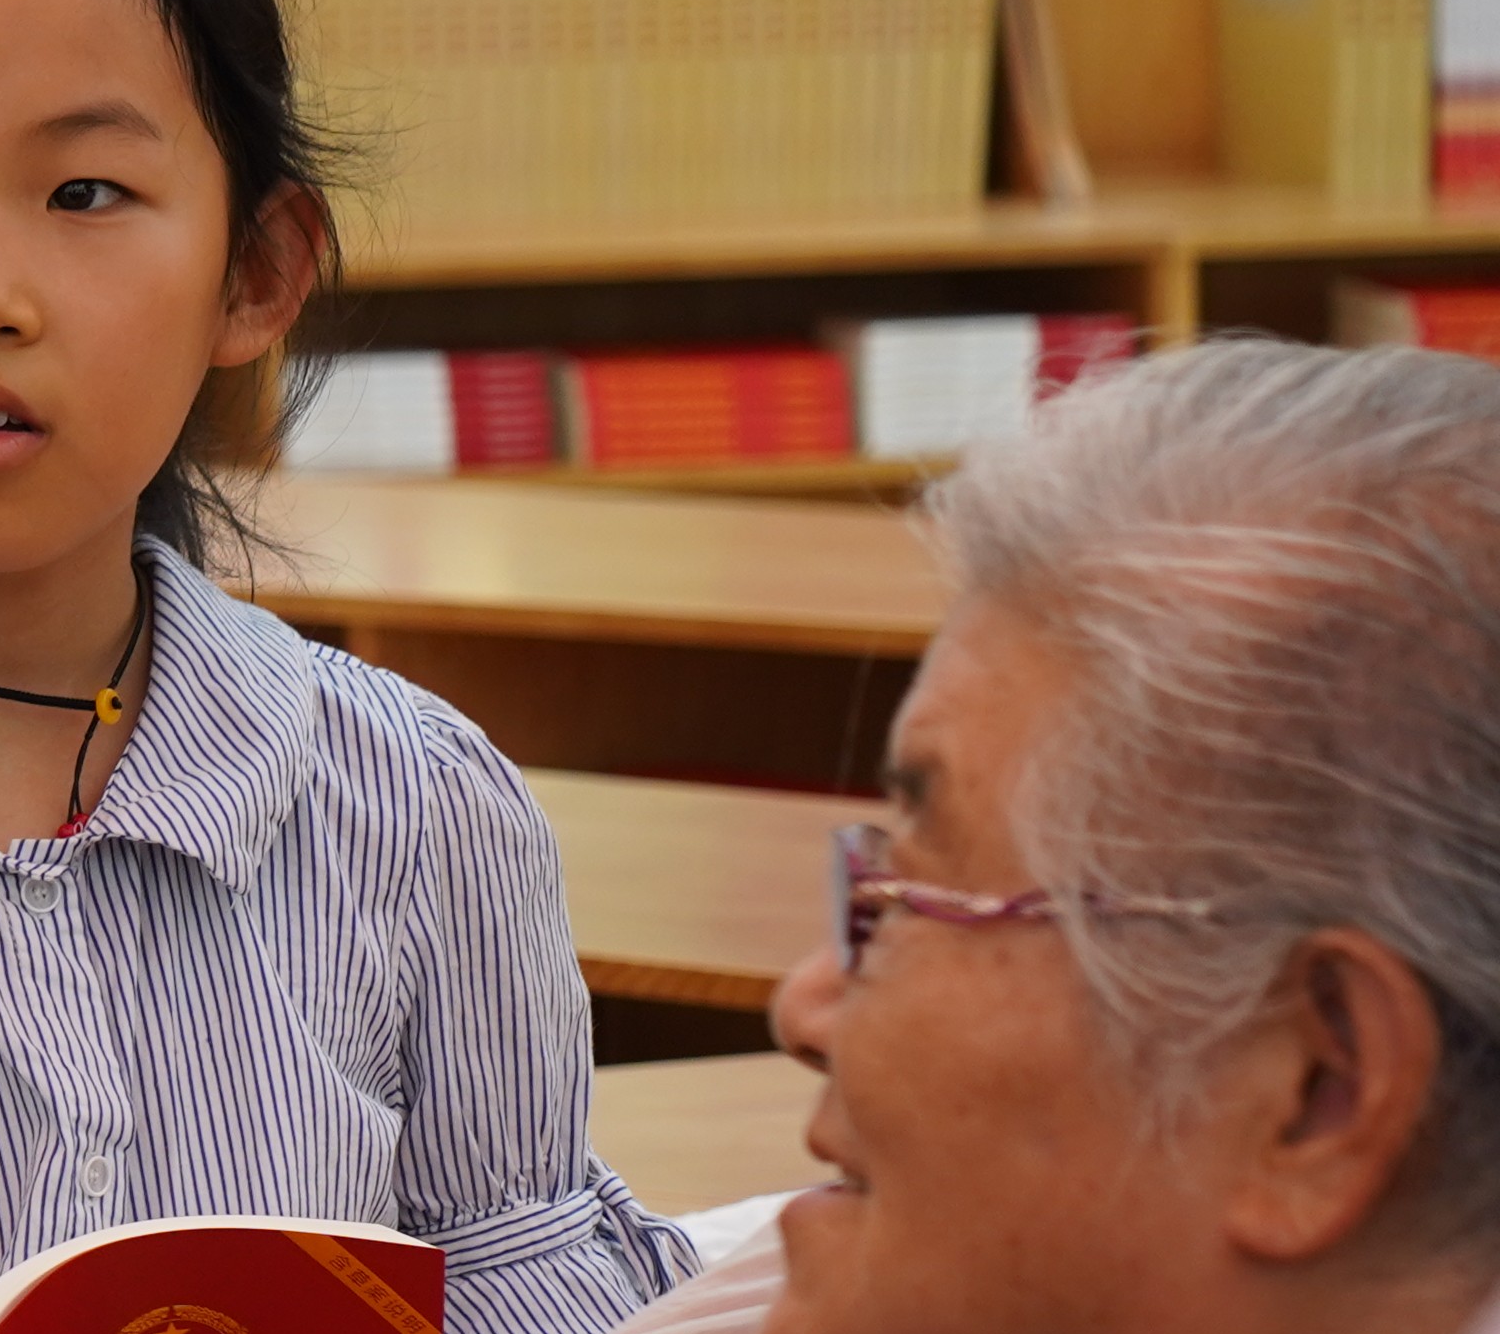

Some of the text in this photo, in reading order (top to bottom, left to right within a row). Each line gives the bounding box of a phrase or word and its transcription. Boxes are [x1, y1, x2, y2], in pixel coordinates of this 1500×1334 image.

[328, 1254, 427, 1334] 含草案说明
